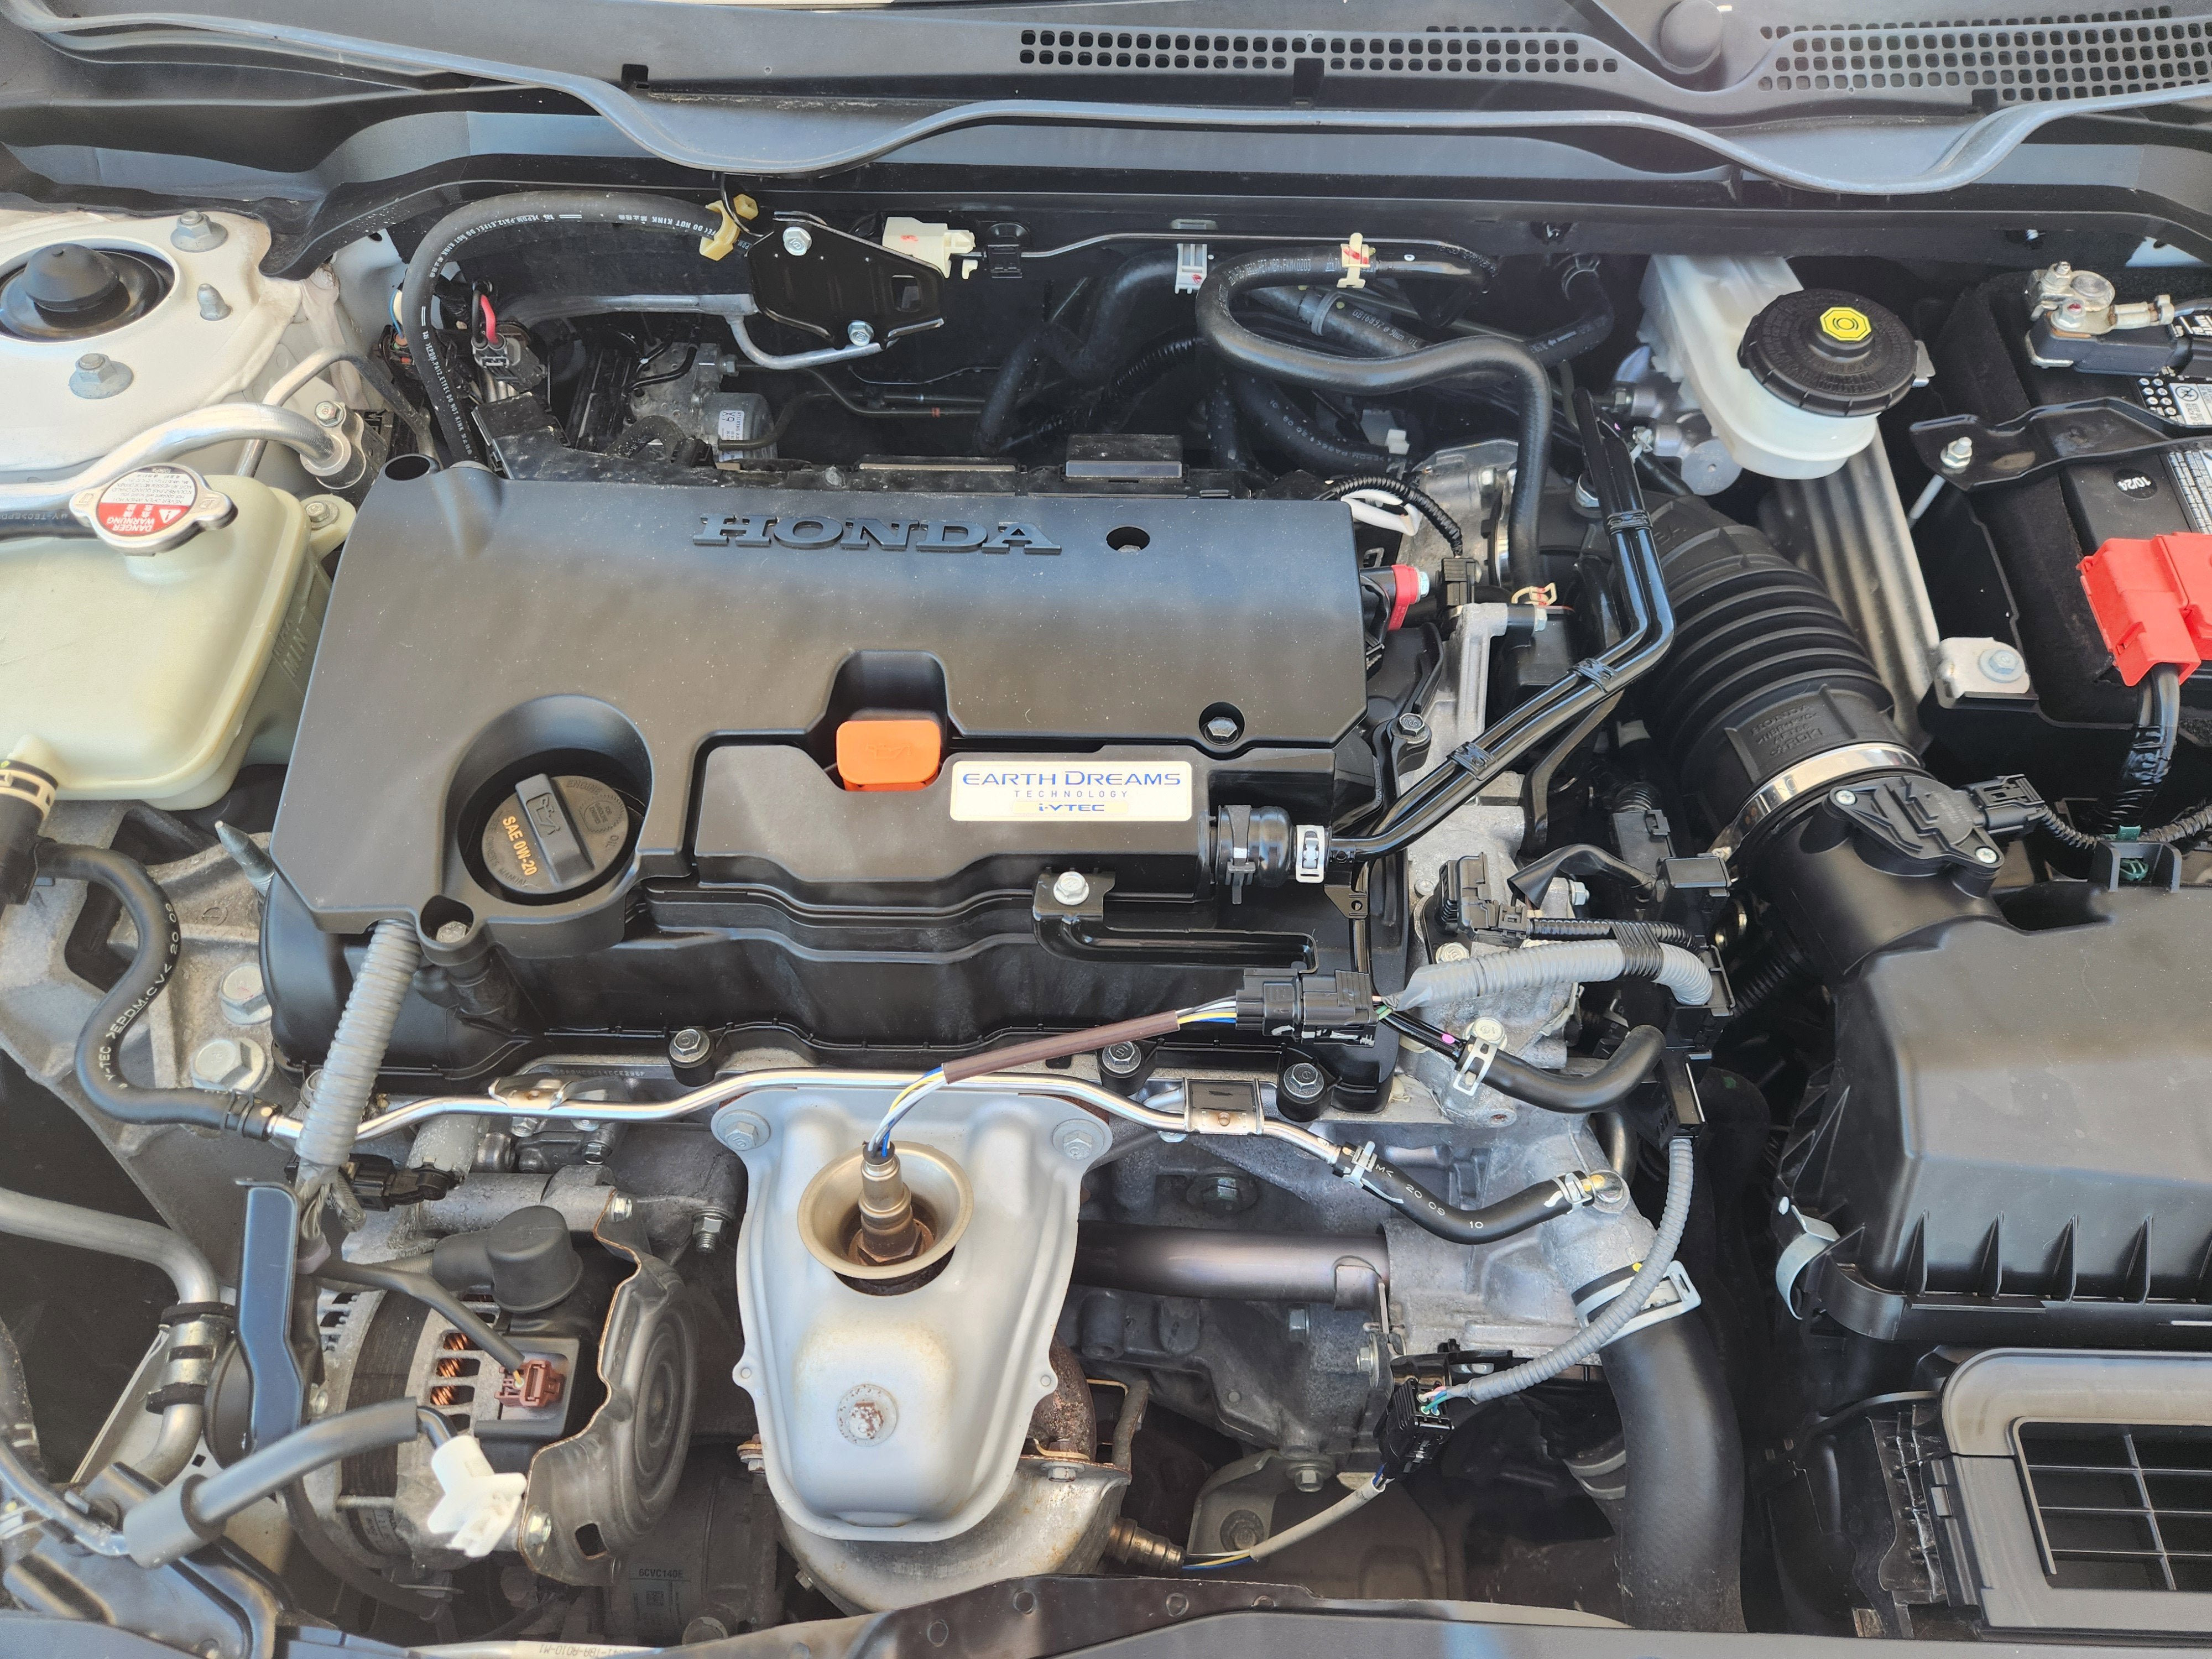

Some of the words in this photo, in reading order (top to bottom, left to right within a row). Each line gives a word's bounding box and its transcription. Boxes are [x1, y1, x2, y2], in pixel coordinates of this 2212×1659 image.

[651, 216, 674, 225] KINK
[675, 220, 692, 228] NOT
[692, 223, 703, 232] DO
[2116, 476, 2152, 492] 10/24
[107, 516, 155, 525] WARNUNG
[112, 524, 153, 532] DANGER
[693, 513, 1062, 554] HONDA
[962, 773, 1057, 786] EARTH
[1065, 770, 1181, 786] DREAMS
[1014, 790, 1129, 798] TECHNOLOGY
[566, 779, 603, 796] ENGINE
[604, 833, 619, 848] OIL
[1038, 803, 1105, 812] i-VTEC
[502, 816, 524, 842] SAE
[513, 840, 538, 877] 0W-20
[165, 902, 177, 923] 09
[170, 931, 179, 955] 20
[1405, 1184, 1423, 1199] 20
[1428, 1201, 1446, 1217] 09
[1469, 1220, 1484, 1229] 10
